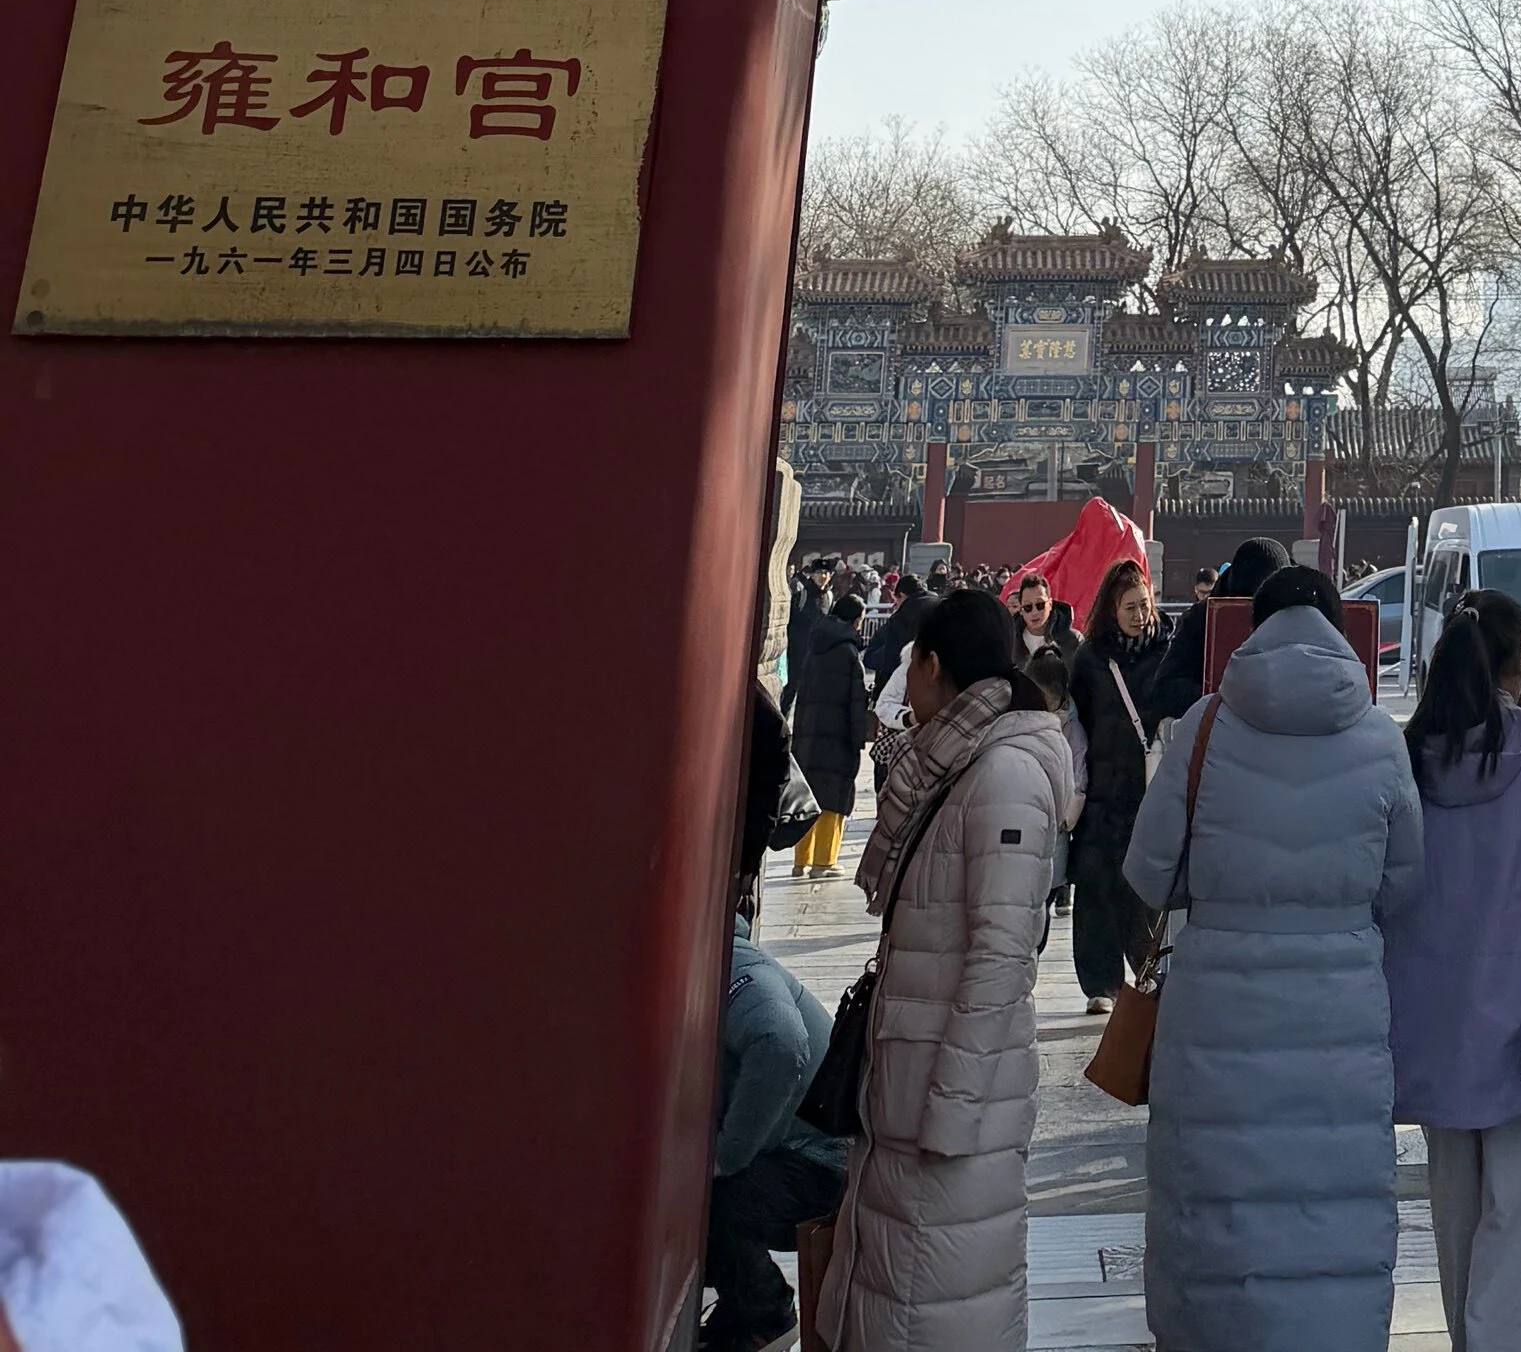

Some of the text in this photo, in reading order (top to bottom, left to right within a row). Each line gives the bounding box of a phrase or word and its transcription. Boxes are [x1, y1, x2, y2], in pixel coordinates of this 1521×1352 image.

[138, 41, 581, 141] 雍和宫
[110, 194, 570, 239] 中华人民共和国国务院
[145, 247, 532, 279] 一九六一年三月四日公布
